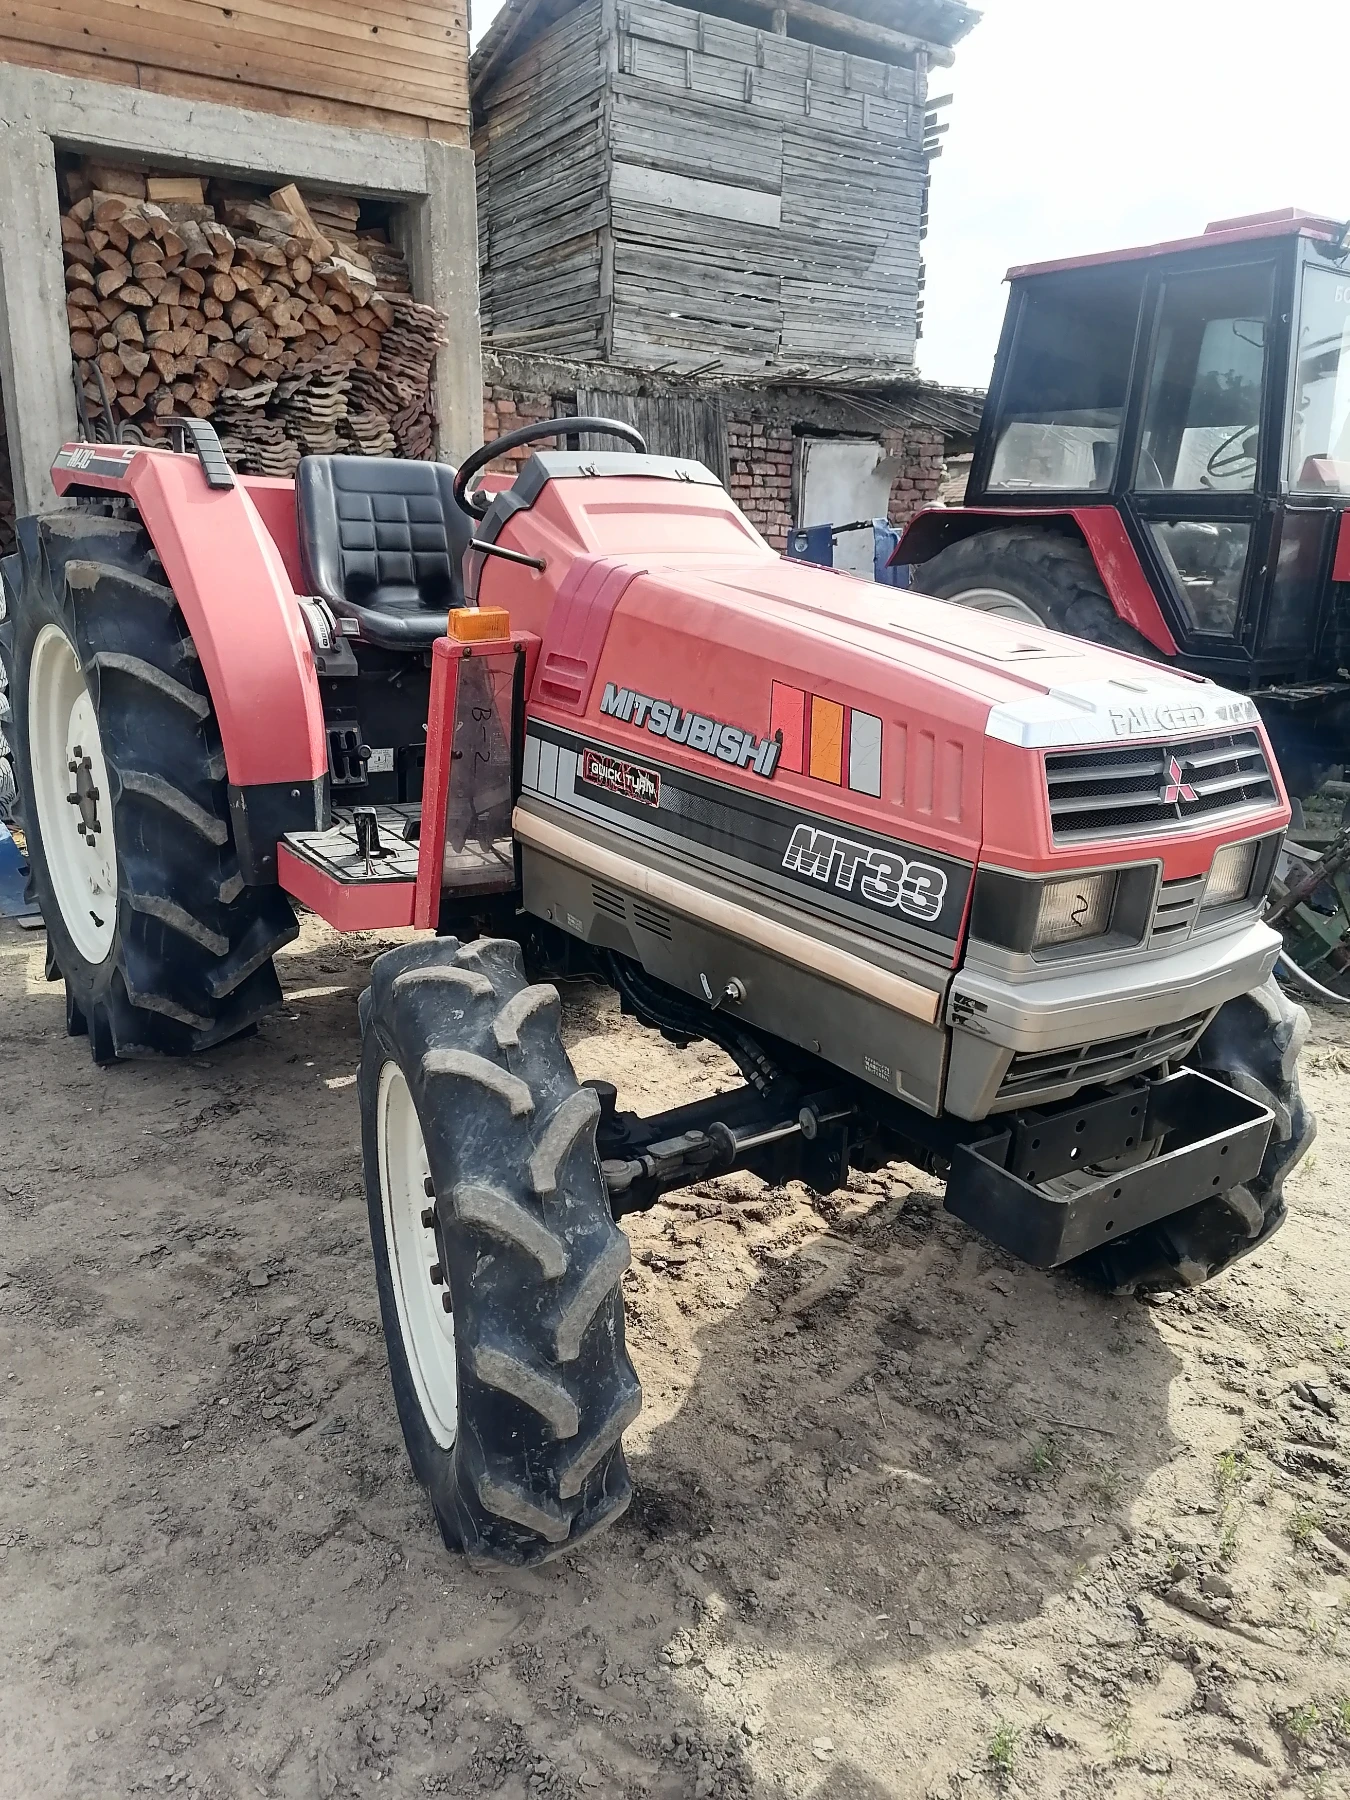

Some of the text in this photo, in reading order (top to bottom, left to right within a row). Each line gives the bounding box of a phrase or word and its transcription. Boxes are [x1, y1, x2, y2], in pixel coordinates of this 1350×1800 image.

[591, 762, 655, 796] QUICK TURN
[600, 682, 782, 779] MITSUBISHI
[781, 823, 949, 922] MT33
